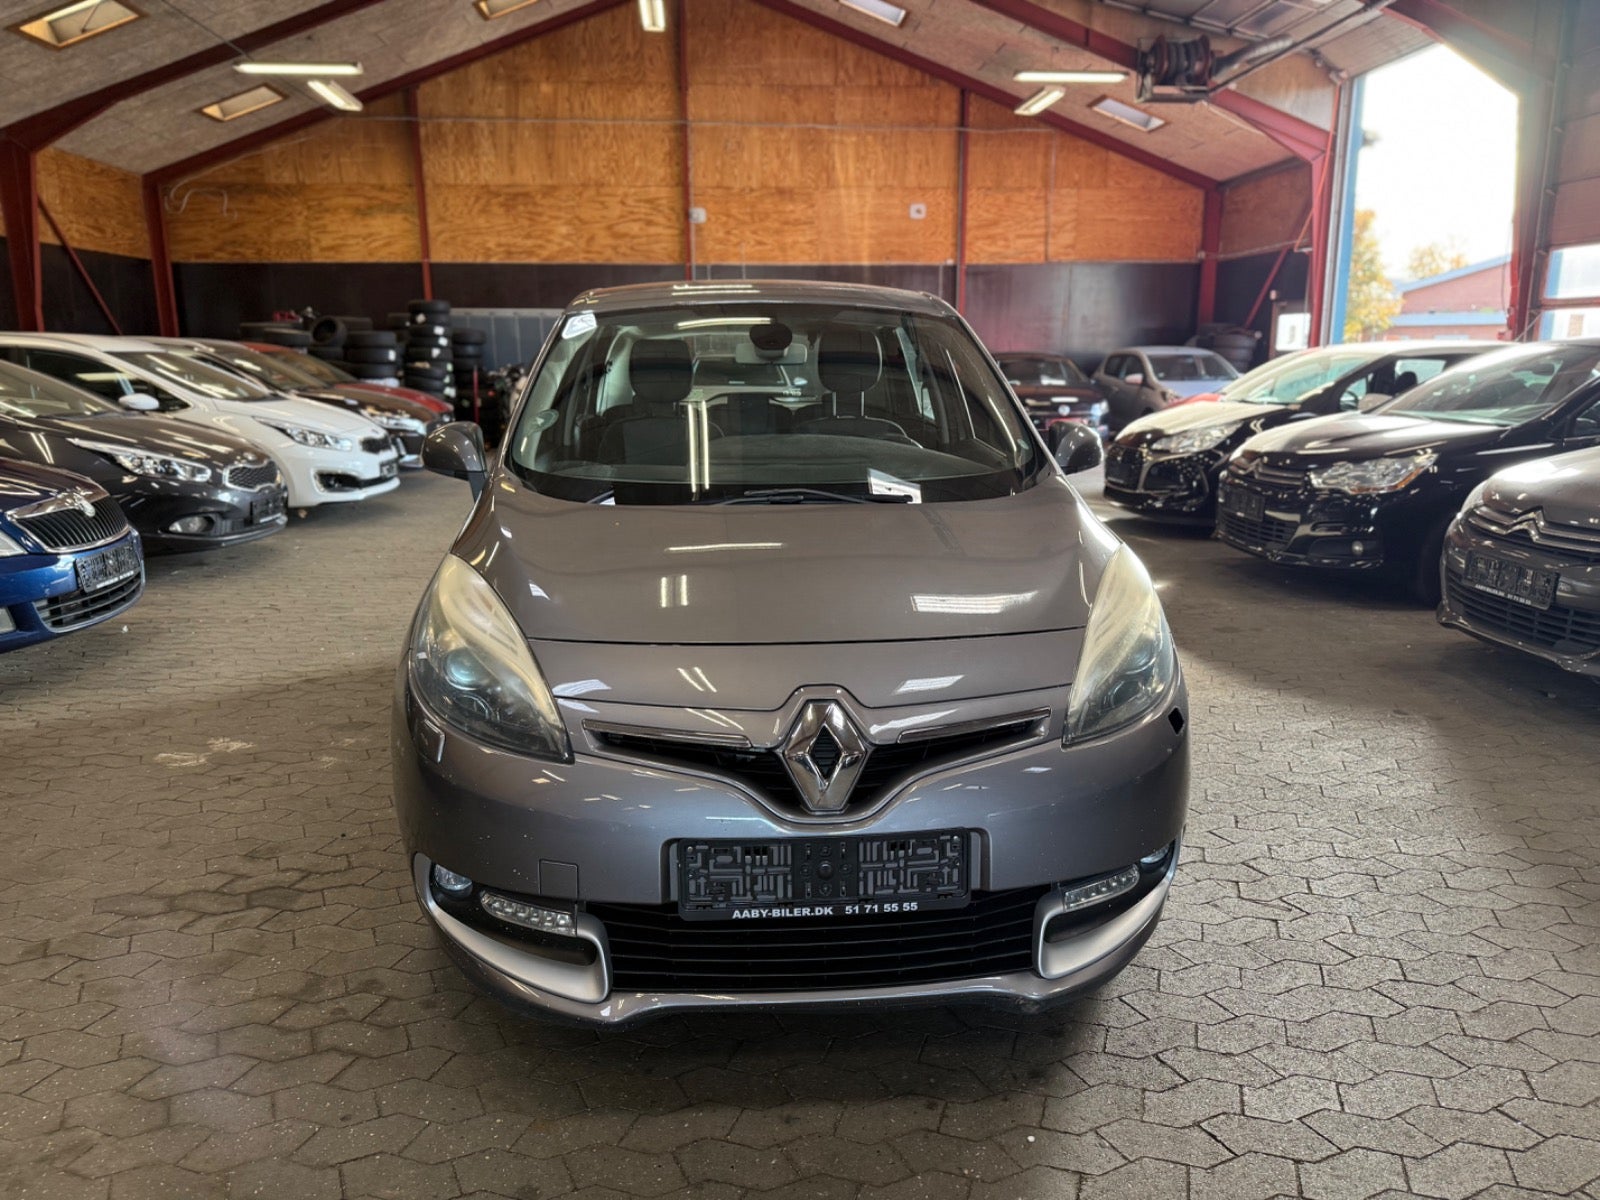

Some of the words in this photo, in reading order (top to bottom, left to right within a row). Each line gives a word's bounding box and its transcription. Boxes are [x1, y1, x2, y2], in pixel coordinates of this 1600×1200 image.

[732, 906, 833, 919] AABY-BILER.DK
[845, 905, 859, 914] 51
[864, 904, 878, 913] 71
[884, 903, 899, 912] 55
[903, 902, 918, 911] 55
